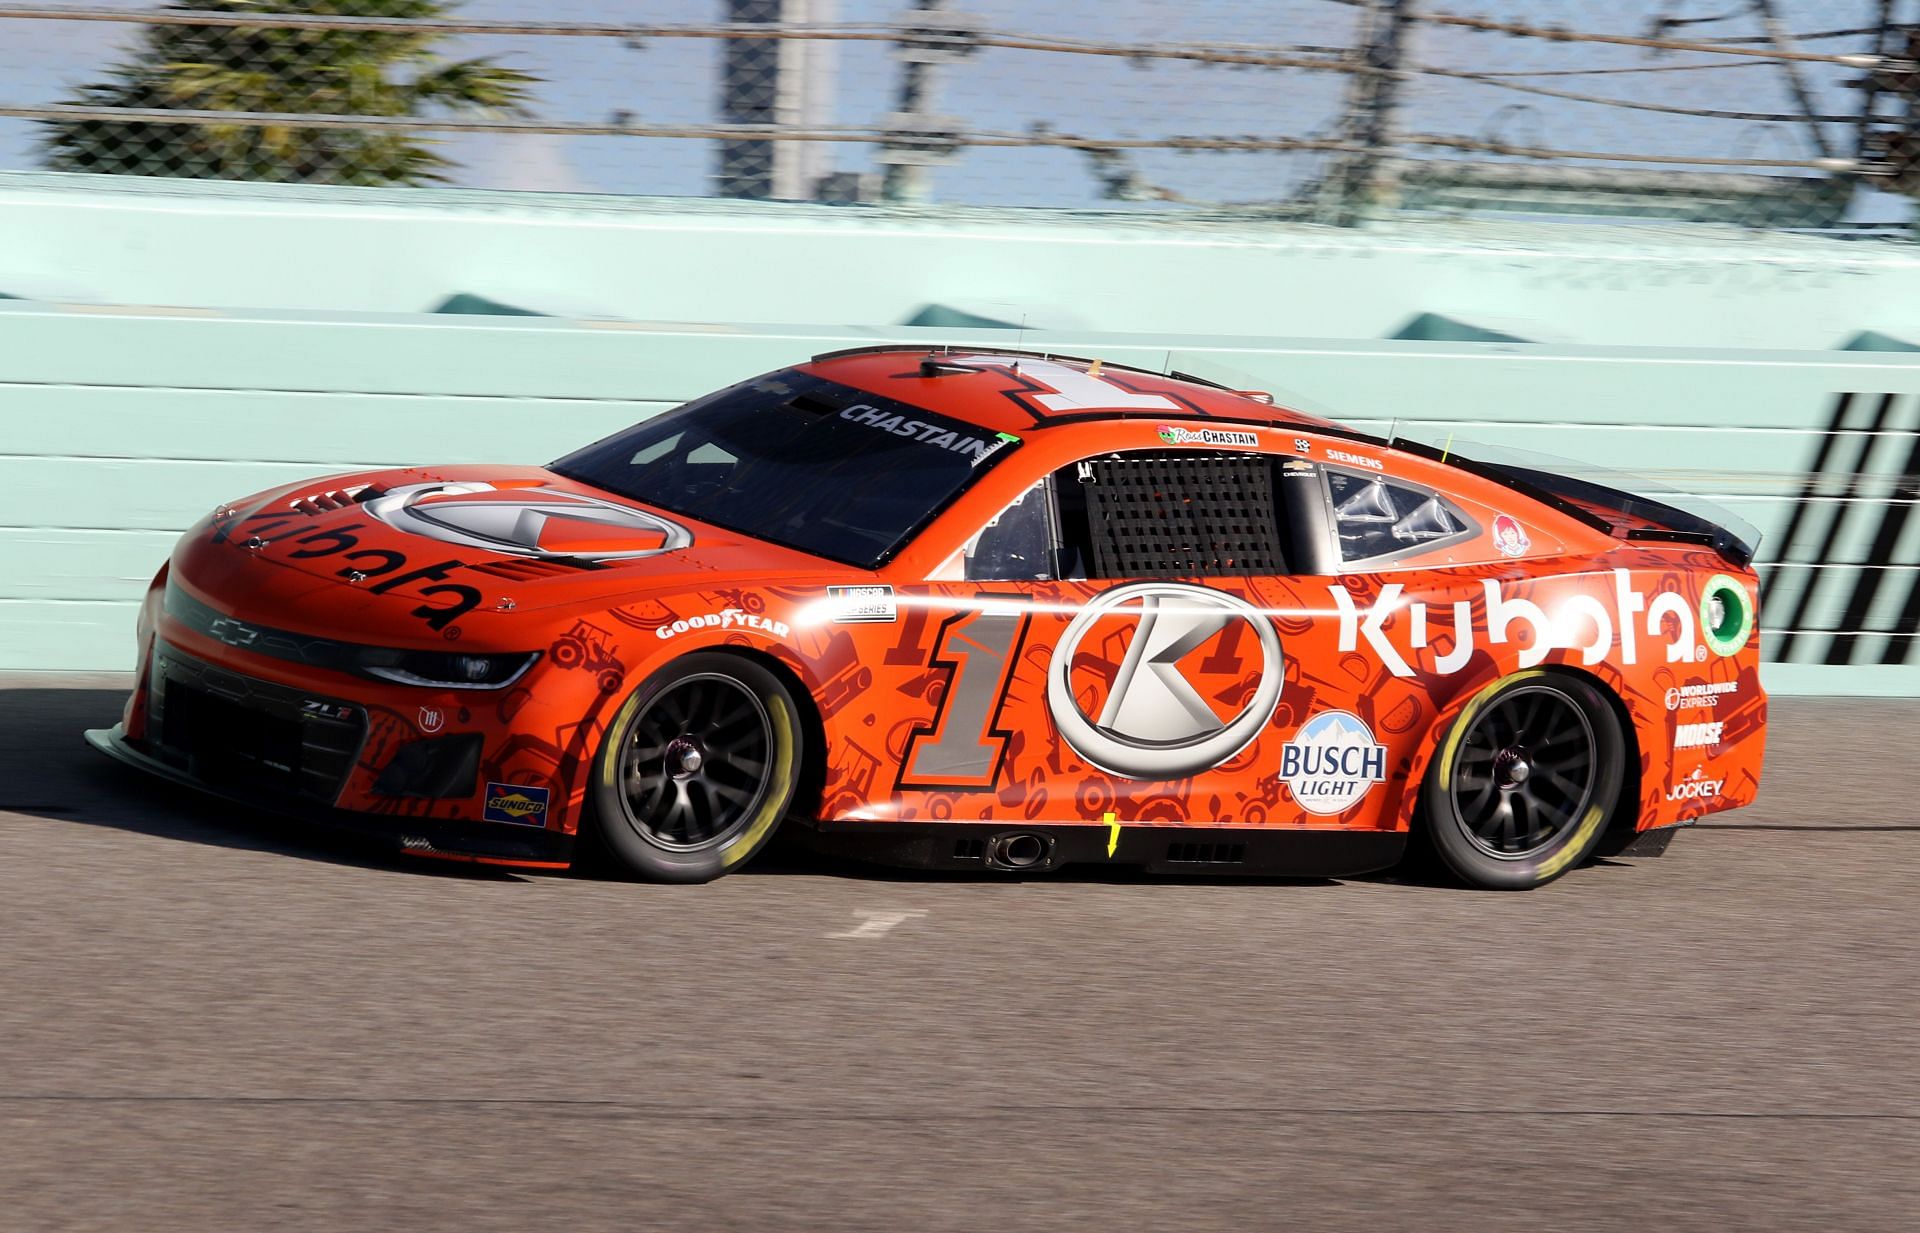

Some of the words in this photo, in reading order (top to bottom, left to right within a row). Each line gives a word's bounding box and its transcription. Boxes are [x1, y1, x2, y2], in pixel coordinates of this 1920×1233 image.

[840, 404, 985, 458] CHASTAIN
[1175, 428, 1202, 442] Ross
[1202, 430, 1257, 445] CHASTAIN
[1326, 449, 1384, 470] SIEMENS
[655, 609, 790, 640] GOODYEAR
[1327, 568, 1695, 678] Kubota
[898, 595, 1030, 789] 1
[1680, 682, 1738, 697] WORLDWIDE
[1680, 696, 1719, 709] EXPRESS
[1674, 722, 1724, 748] MOOSE
[1282, 745, 1384, 779] BUSCH
[1300, 780, 1358, 796] LIGHT
[1666, 780, 1724, 801] JOCKEY
[490, 797, 543, 814] SUNOCO
